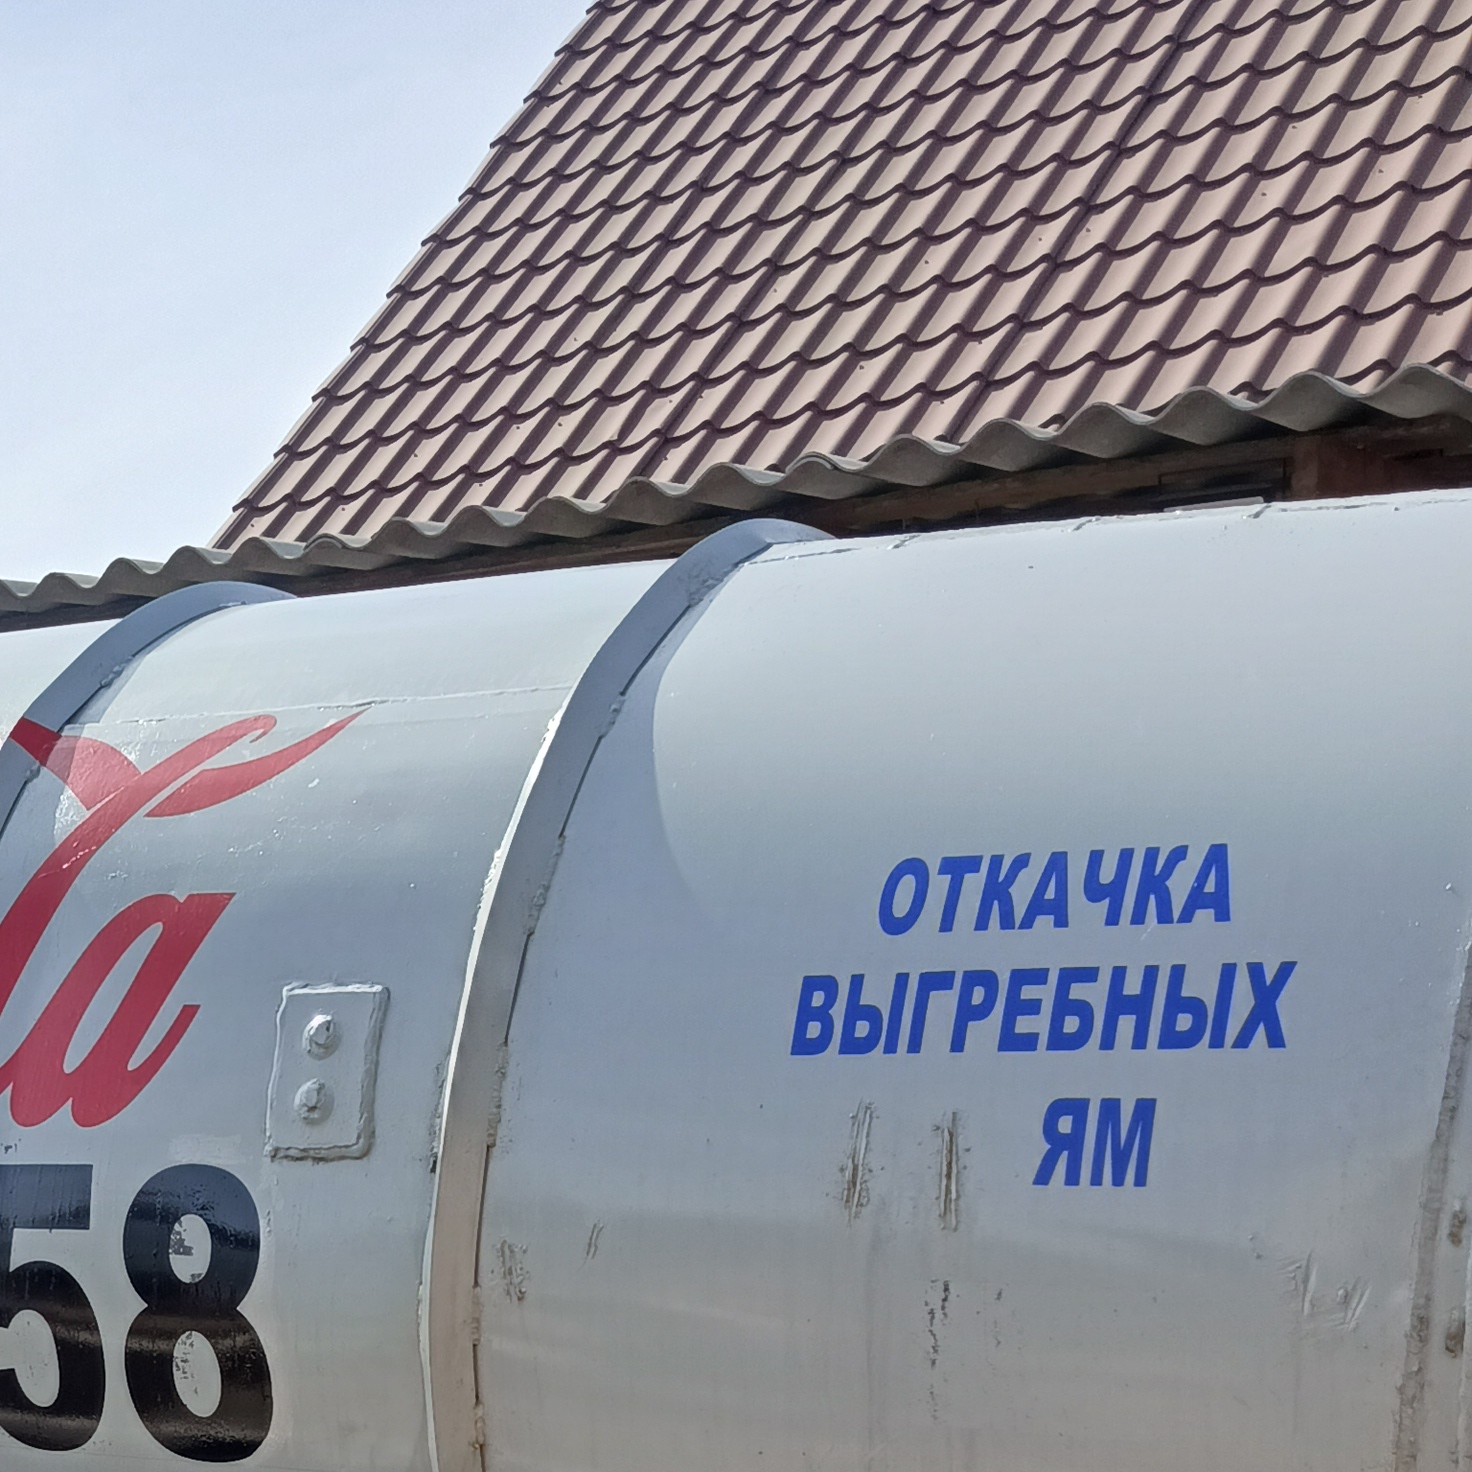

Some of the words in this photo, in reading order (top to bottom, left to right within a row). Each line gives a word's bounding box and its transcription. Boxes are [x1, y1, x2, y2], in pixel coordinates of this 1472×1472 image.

[878, 843, 1231, 936] ОТКАЧКА
[790, 961, 1298, 1056] ВЫГРЕБНЫХ
[1032, 1097, 1157, 1187] ЯМ
